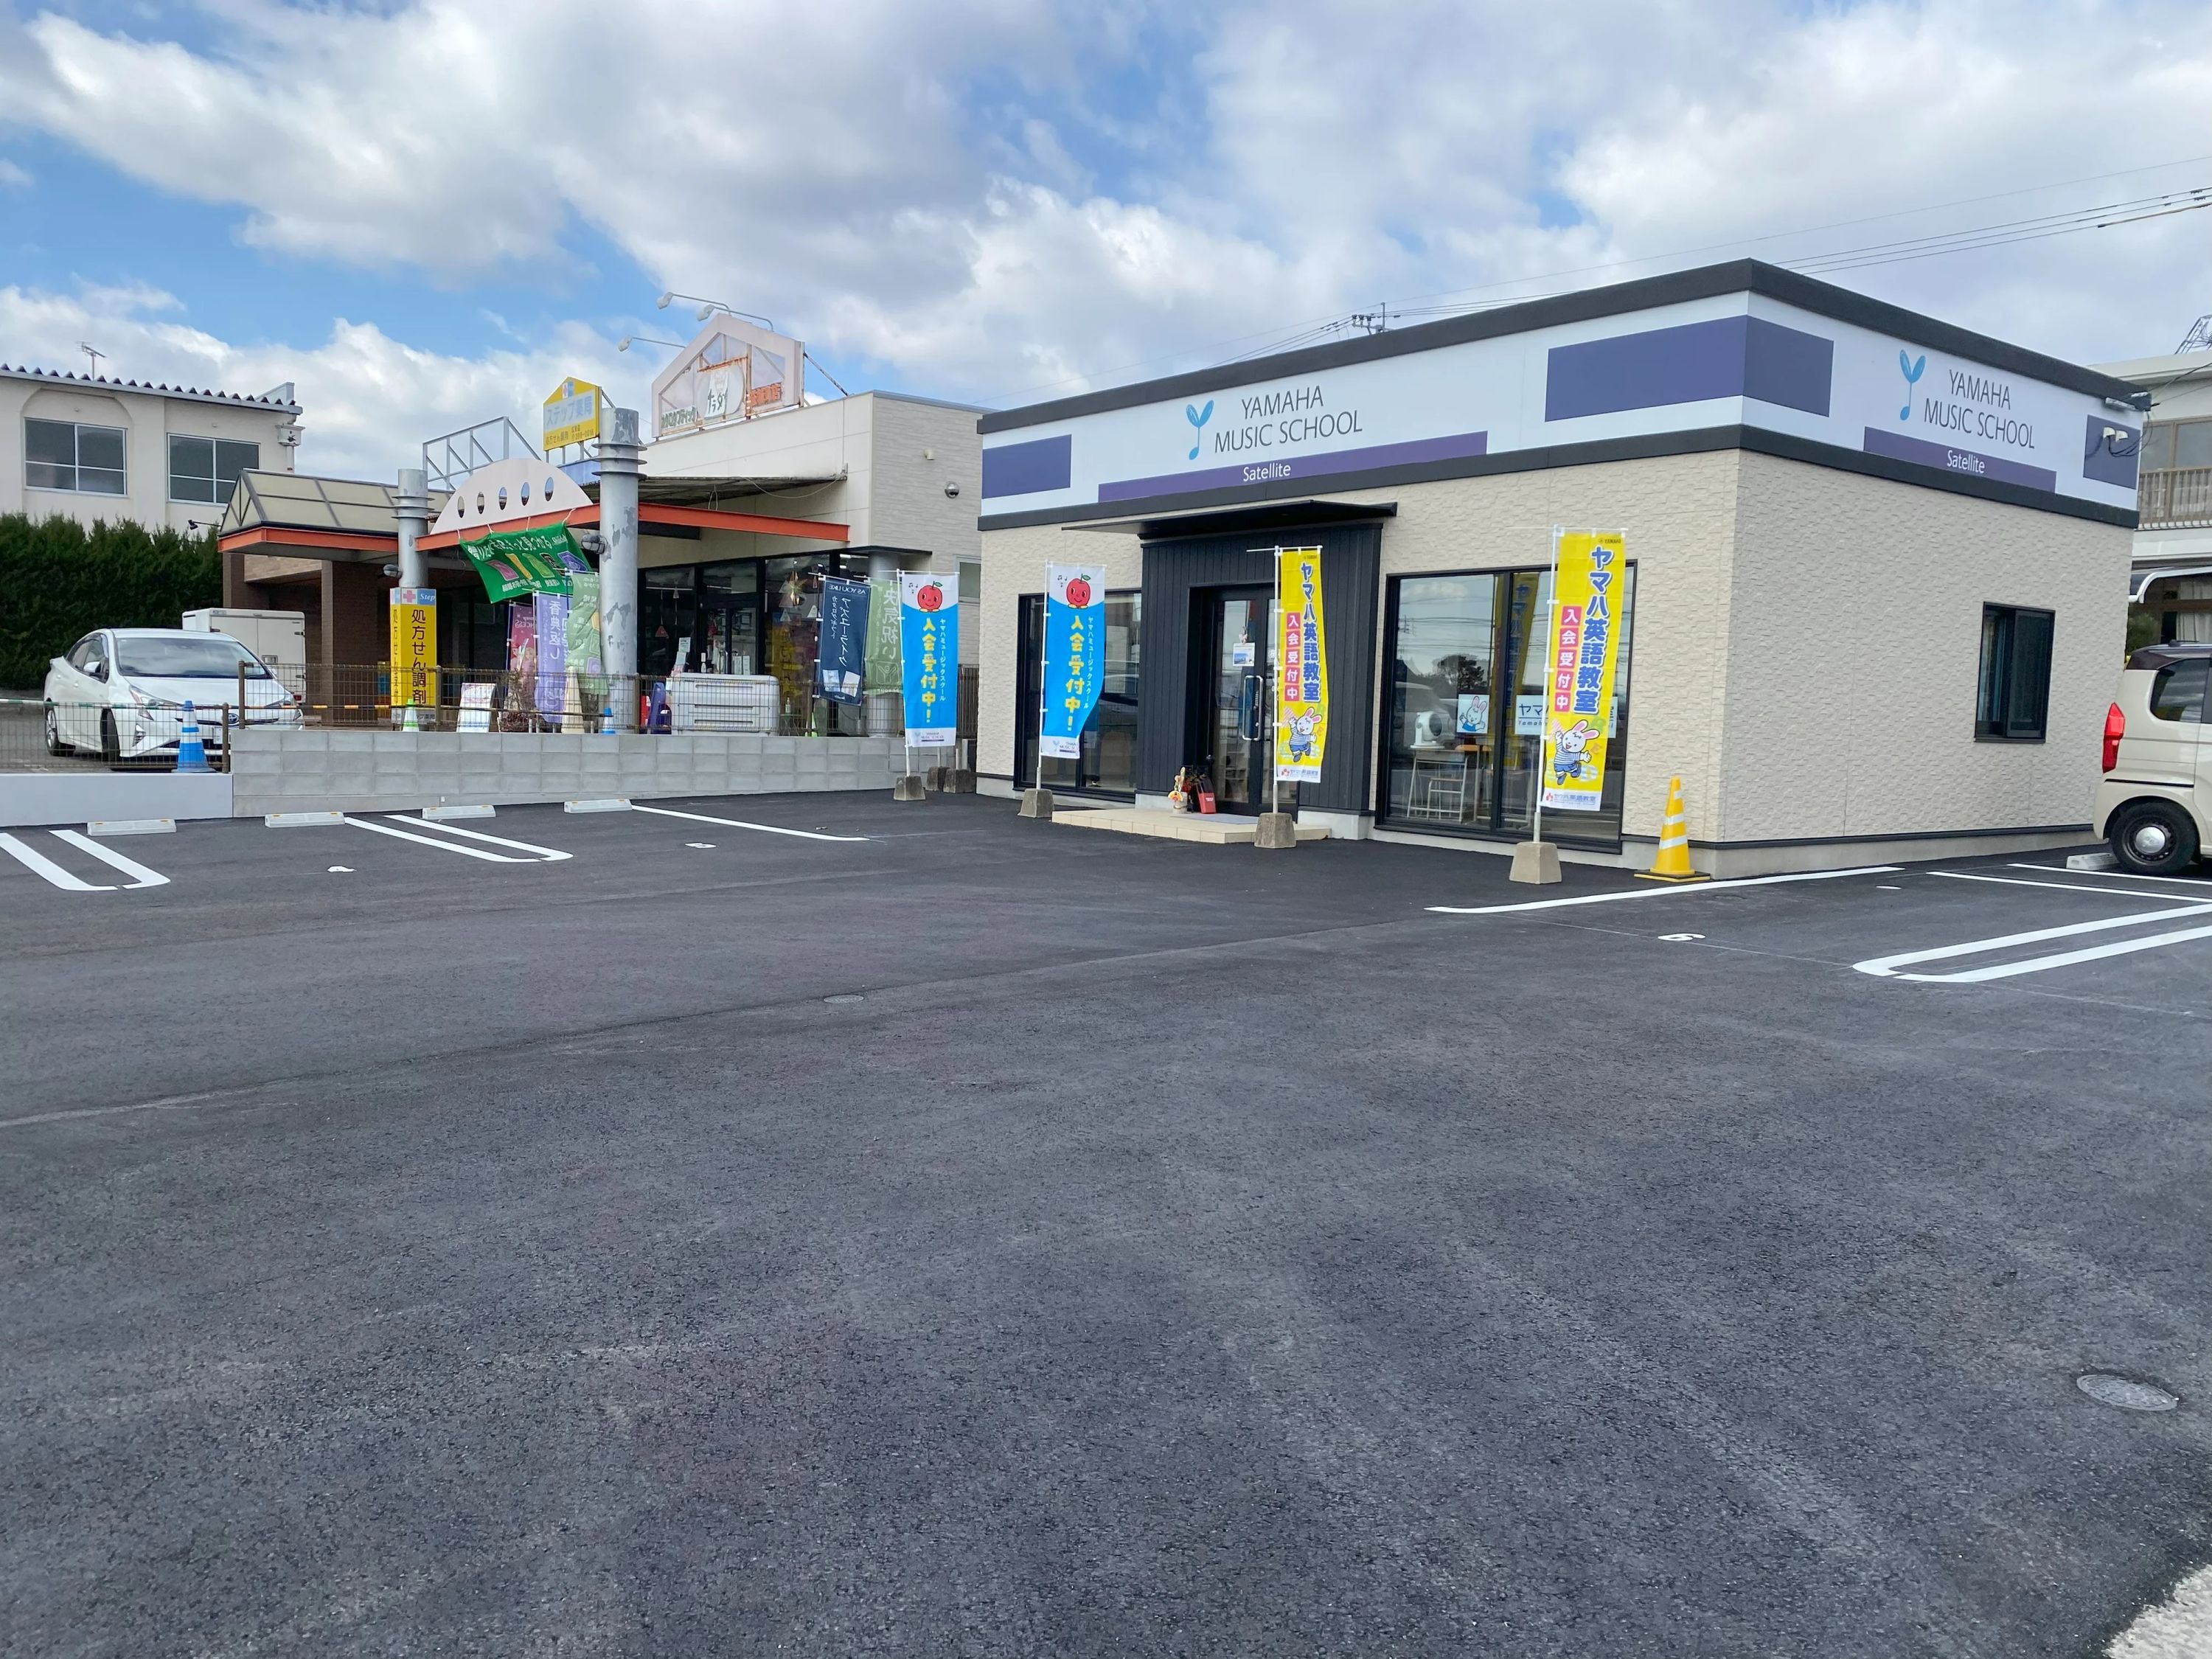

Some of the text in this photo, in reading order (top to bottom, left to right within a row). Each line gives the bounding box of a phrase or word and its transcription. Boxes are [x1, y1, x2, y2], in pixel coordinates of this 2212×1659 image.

[546, 396, 592, 426] ステップ薬局
[1242, 386, 1324, 420] YAMAHA
[1949, 369, 2011, 410] YAMAHA
[1215, 410, 1363, 453] MUSIC SCHOOL
[1924, 397, 2035, 449] MUSIC SCHOOL
[1243, 462, 1291, 482] Satellite
[1947, 450, 1986, 473] Satellite
[420, 593, 436, 602] Step
[1301, 563, 1321, 703] ヤマハ英語教室
[1573, 546, 1614, 714] ヤマハ英語教室
[411, 609, 426, 704] 処方せん調剤
[1084, 616, 1094, 709] ヤマハミュージックスクール
[1287, 613, 1300, 699] 入会受付中
[1557, 608, 1579, 709] 入会受付中
[1519, 703, 1548, 717] ヤマ
